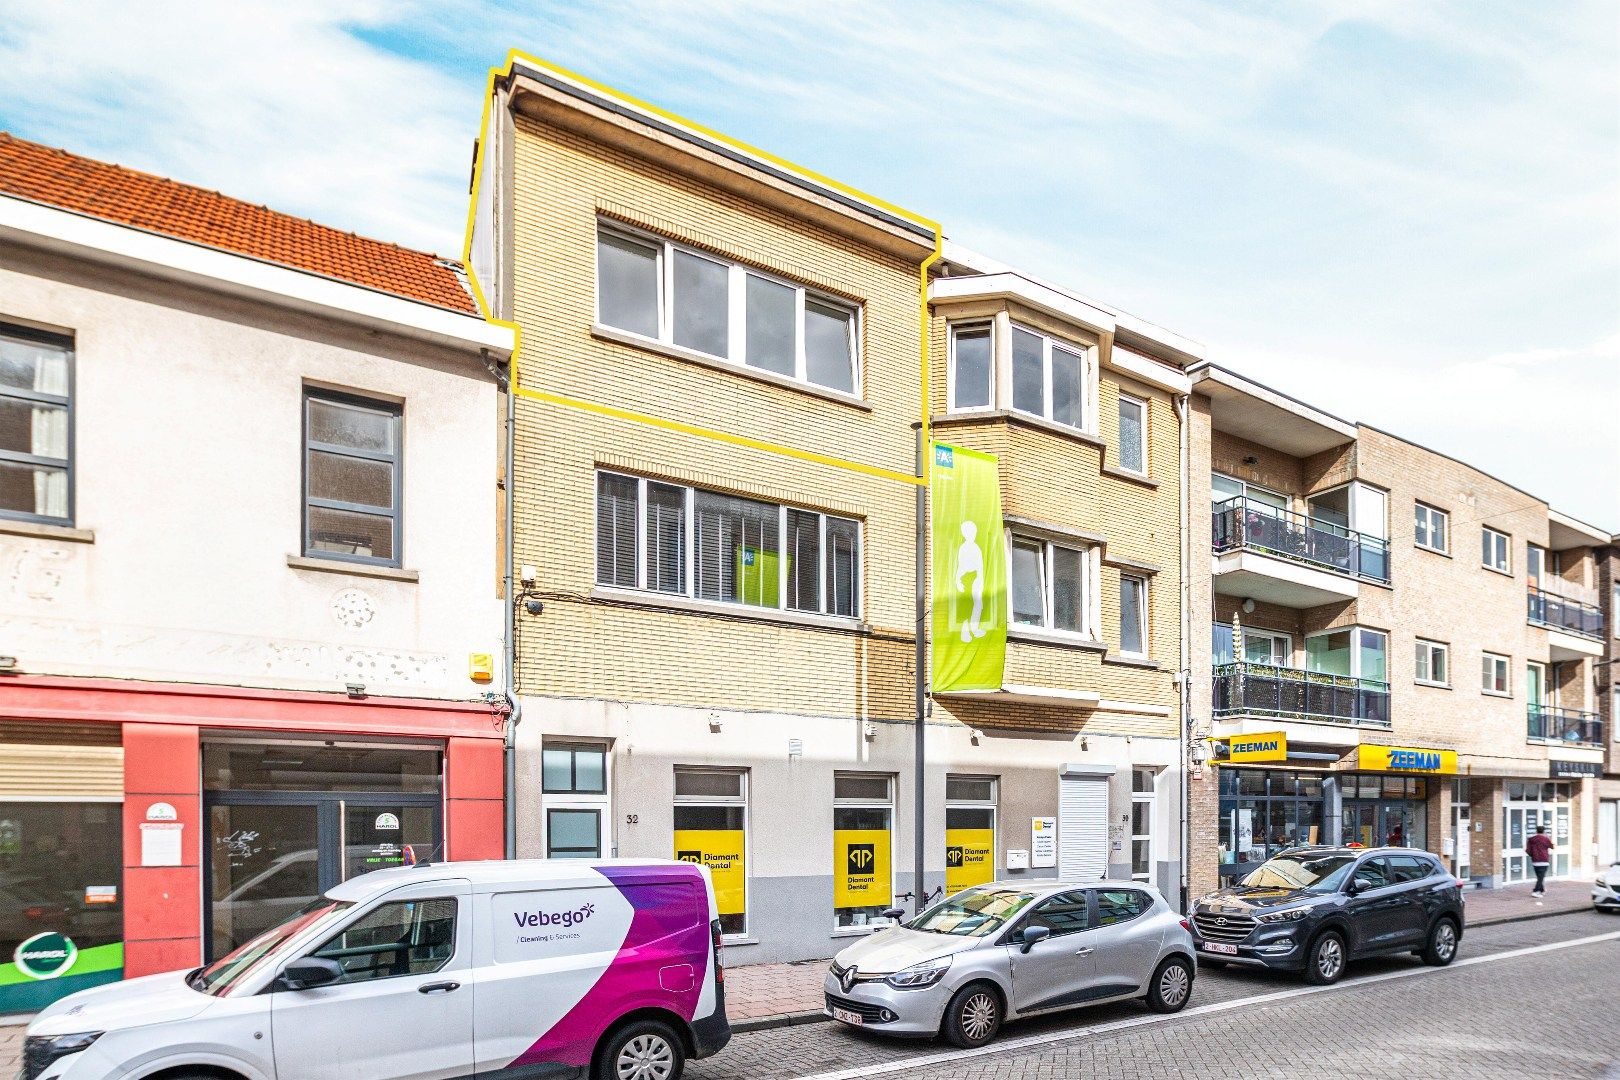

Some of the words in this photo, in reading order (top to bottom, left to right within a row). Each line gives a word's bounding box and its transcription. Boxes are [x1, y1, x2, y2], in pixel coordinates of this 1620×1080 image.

[1232, 741, 1278, 754] ZEEMAN
[1390, 750, 1441, 769] ZEEMAN
[626, 814, 639, 824] 32
[704, 853, 739, 861] Diamant
[704, 861, 731, 869] Dental
[513, 910, 584, 928] Vebego
[520, 934, 548, 943] Cleaning
[555, 932, 581, 940] Services
